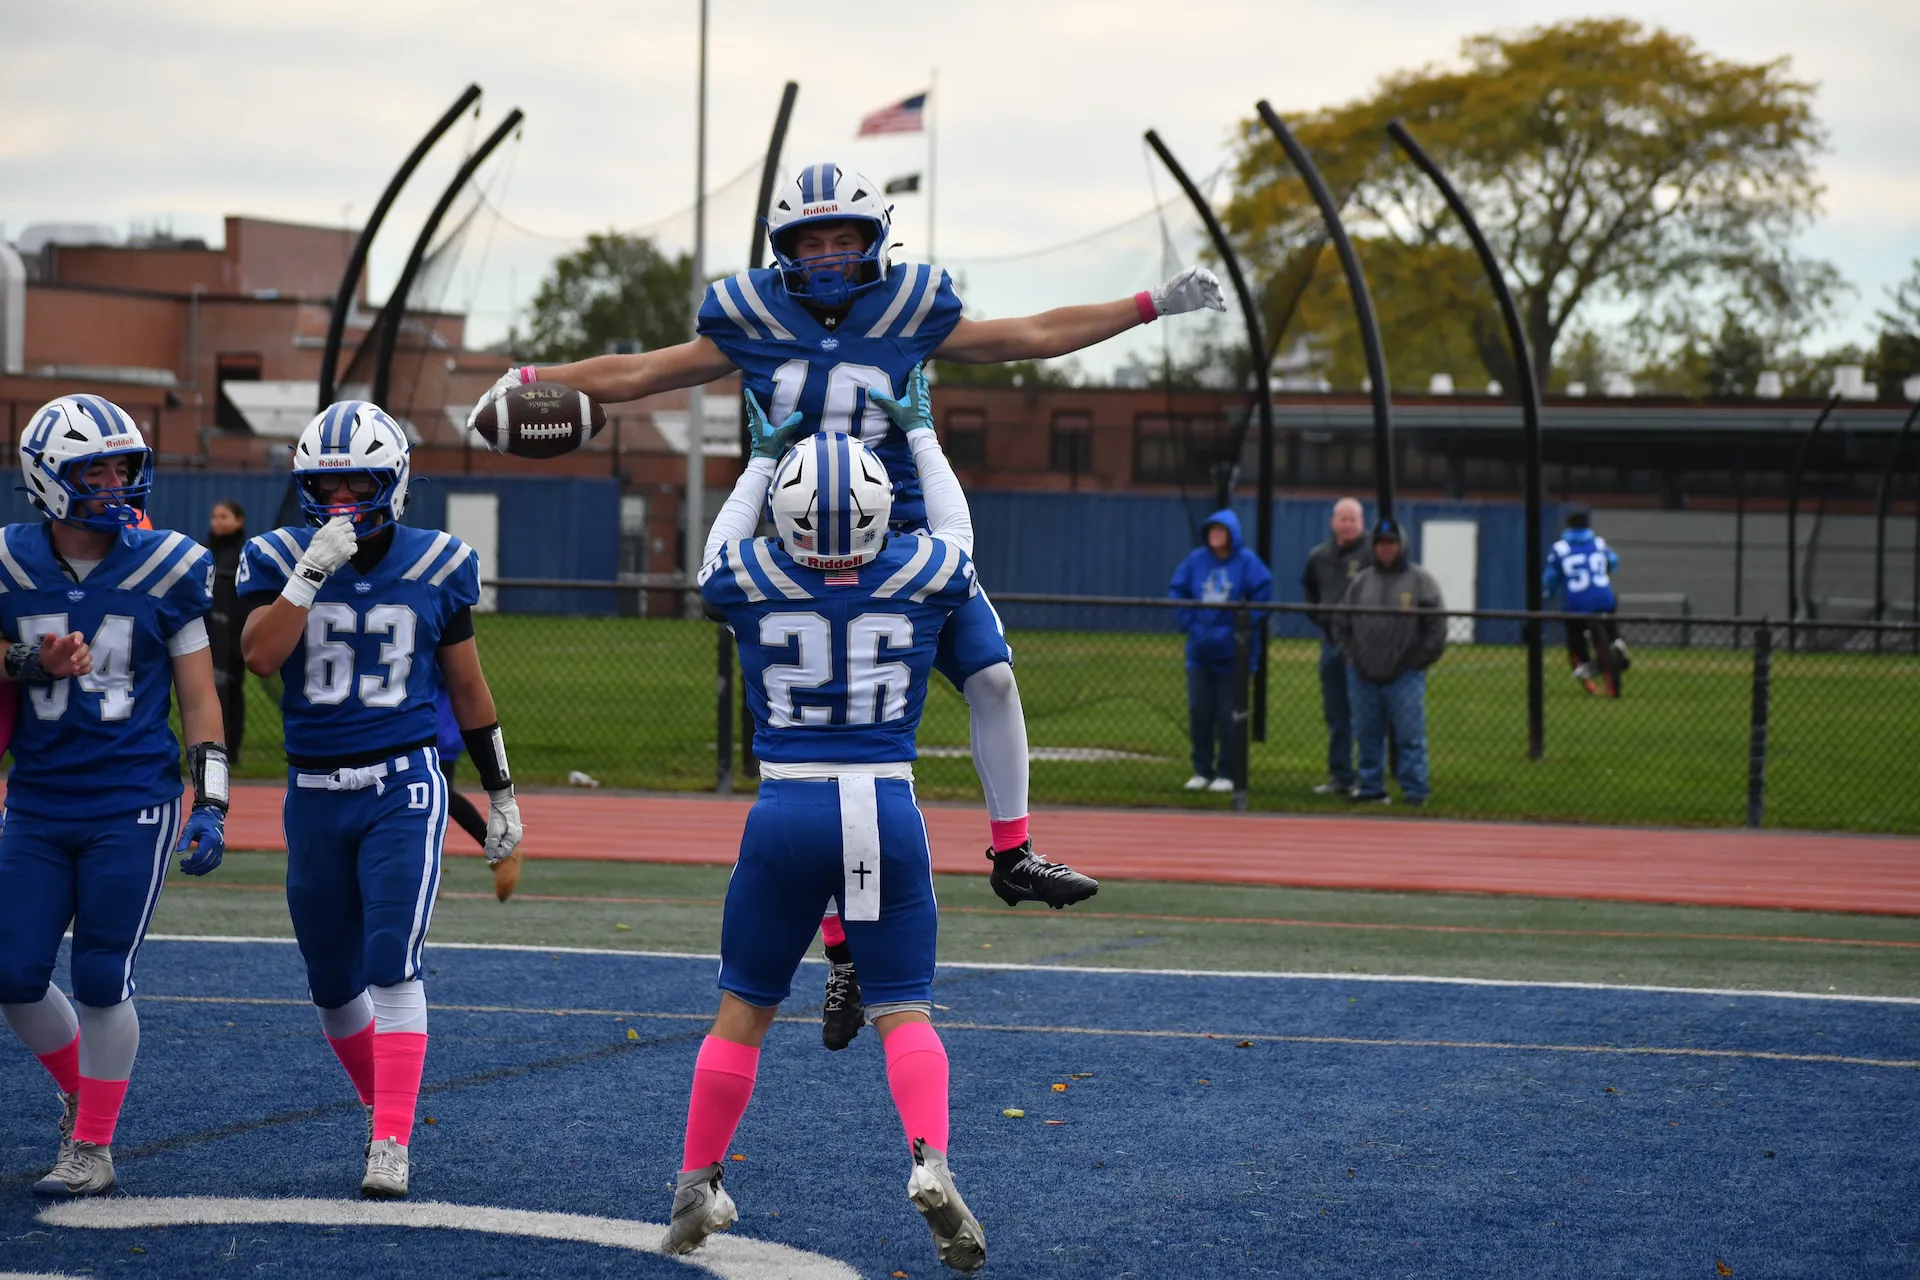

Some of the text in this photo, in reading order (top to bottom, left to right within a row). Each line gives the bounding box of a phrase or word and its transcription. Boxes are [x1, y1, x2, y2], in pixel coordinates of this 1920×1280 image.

[803, 204, 839, 216] Riddell
[768, 359, 896, 449] 10
[28, 409, 61, 451] D
[105, 438, 135, 449] Riddell
[318, 459, 351, 467] Riddell
[864, 530, 875, 542] 26
[807, 555, 863, 569] Riddell
[16, 612, 135, 721] 54
[303, 602, 417, 708] 63
[759, 611, 914, 729] 26
[407, 781, 430, 810] D
